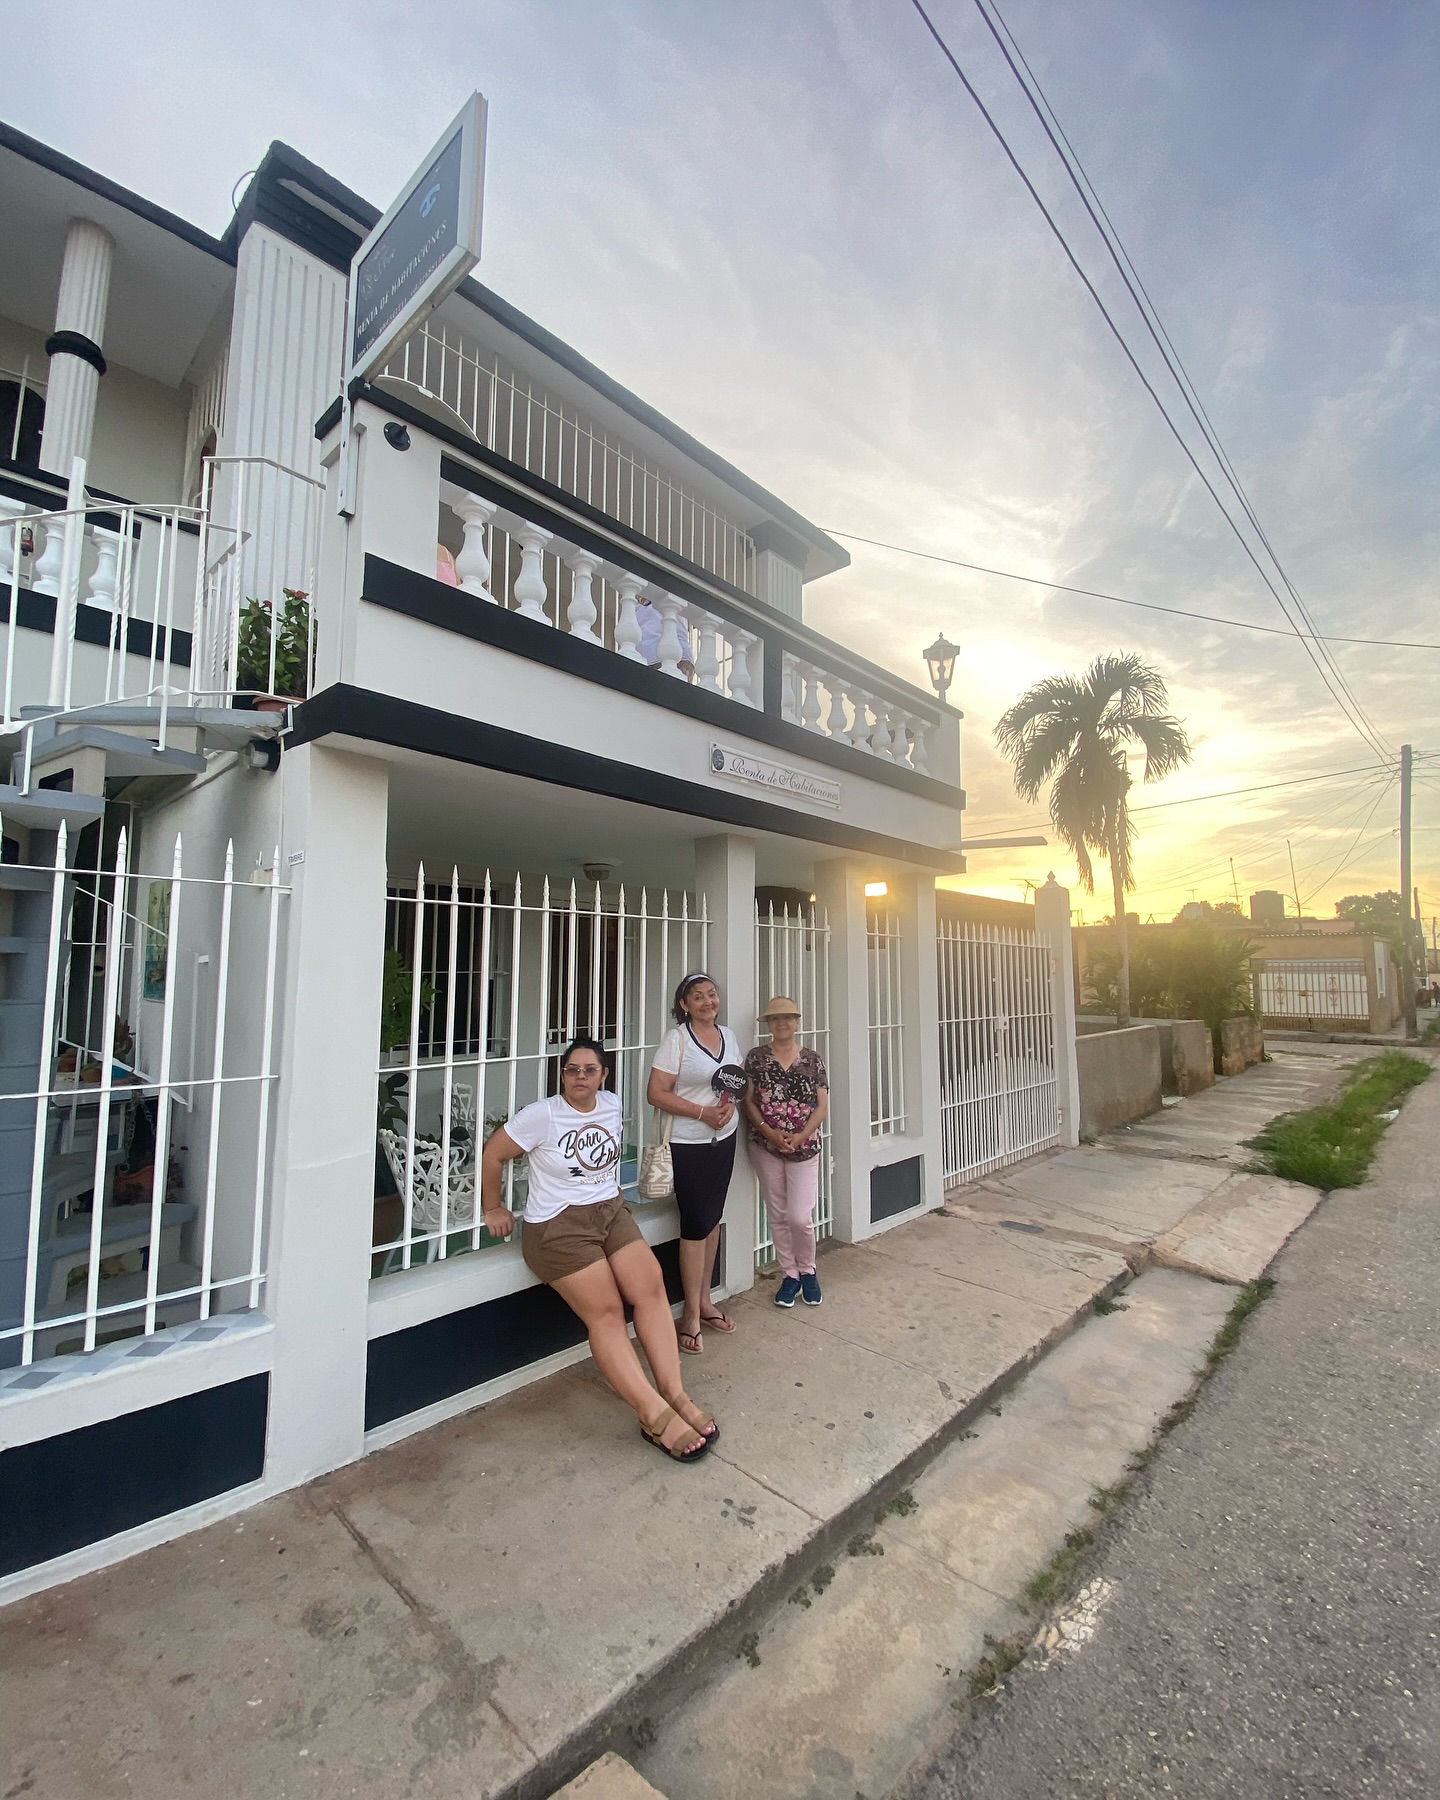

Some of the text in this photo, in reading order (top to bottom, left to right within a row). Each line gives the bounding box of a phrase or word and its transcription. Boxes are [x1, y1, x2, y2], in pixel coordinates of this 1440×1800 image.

[357, 305, 379, 338] RENTA
[380, 293, 389, 311] DE
[391, 219, 447, 297] HABITACIONES
[729, 758, 765, 780] Renta
[767, 769, 778, 785] de
[779, 770, 839, 800] Habitaciones
[718, 1069, 746, 1085] Legendario
[558, 1130, 602, 1159] Born
